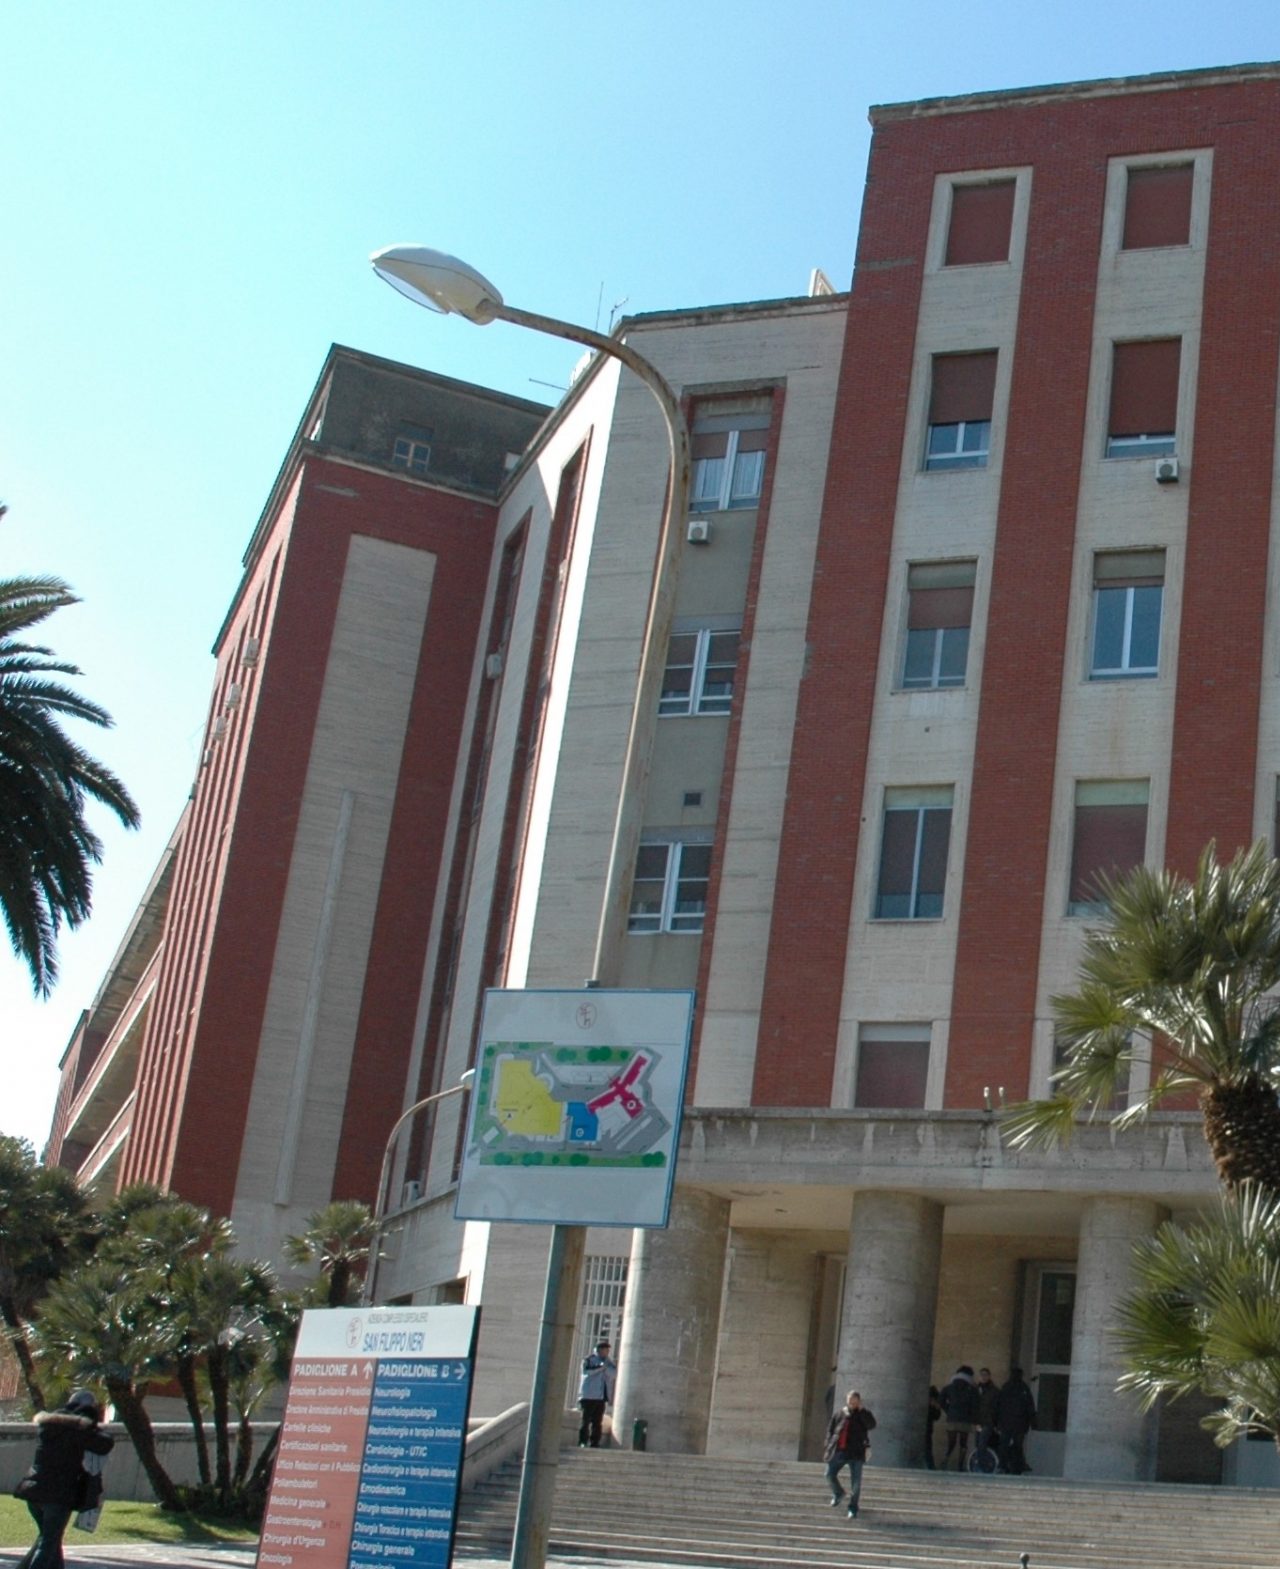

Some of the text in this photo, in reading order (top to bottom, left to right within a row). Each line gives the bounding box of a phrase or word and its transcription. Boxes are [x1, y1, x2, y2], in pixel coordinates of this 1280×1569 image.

[363, 1332, 378, 1352] SAN
[378, 1332, 407, 1352] FILIPPO
[407, 1331, 426, 1352] NERI
[294, 1363, 358, 1376] PADIGLIONE A
[377, 1363, 450, 1378] PADIGLIONE B
[318, 1386, 345, 1396] Sanitaria
[374, 1387, 411, 1400] Neurologia
[371, 1406, 437, 1420] Neurofisiopatologia
[283, 1422, 332, 1433] Cartelle cliniche
[414, 1427, 435, 1439] terapia
[280, 1440, 348, 1453] Certificazioni sanitarie
[365, 1443, 405, 1458] Cardiologia
[409, 1446, 428, 1457] UTIC
[273, 1477, 318, 1488] Poliambulatori
[360, 1482, 406, 1496] Emodinamica
[270, 1495, 326, 1510] Medicina generale
[357, 1501, 380, 1516] Chirurgia
[266, 1514, 322, 1530] Gastroenterologia
[354, 1521, 378, 1536] Chirurgia
[263, 1532, 325, 1548] Chirurgia d'Urgenza
[351, 1540, 415, 1557] Chirurgia generale
[260, 1552, 293, 1566] Oncologia
